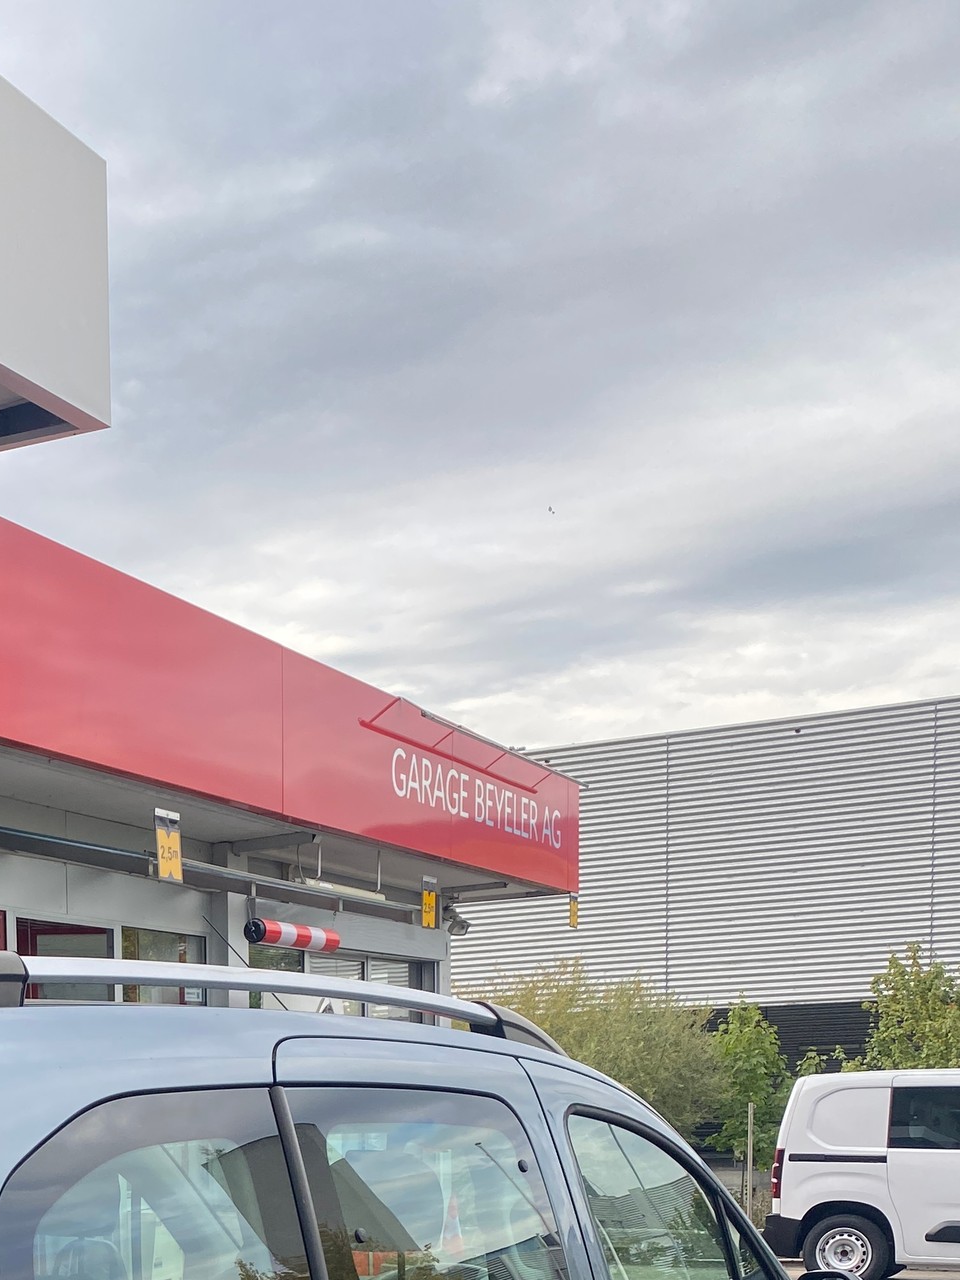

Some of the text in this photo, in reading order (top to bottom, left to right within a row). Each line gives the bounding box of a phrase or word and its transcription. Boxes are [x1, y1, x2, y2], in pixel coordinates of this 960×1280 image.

[392, 747, 562, 849] GARAGE BEYELER AG
